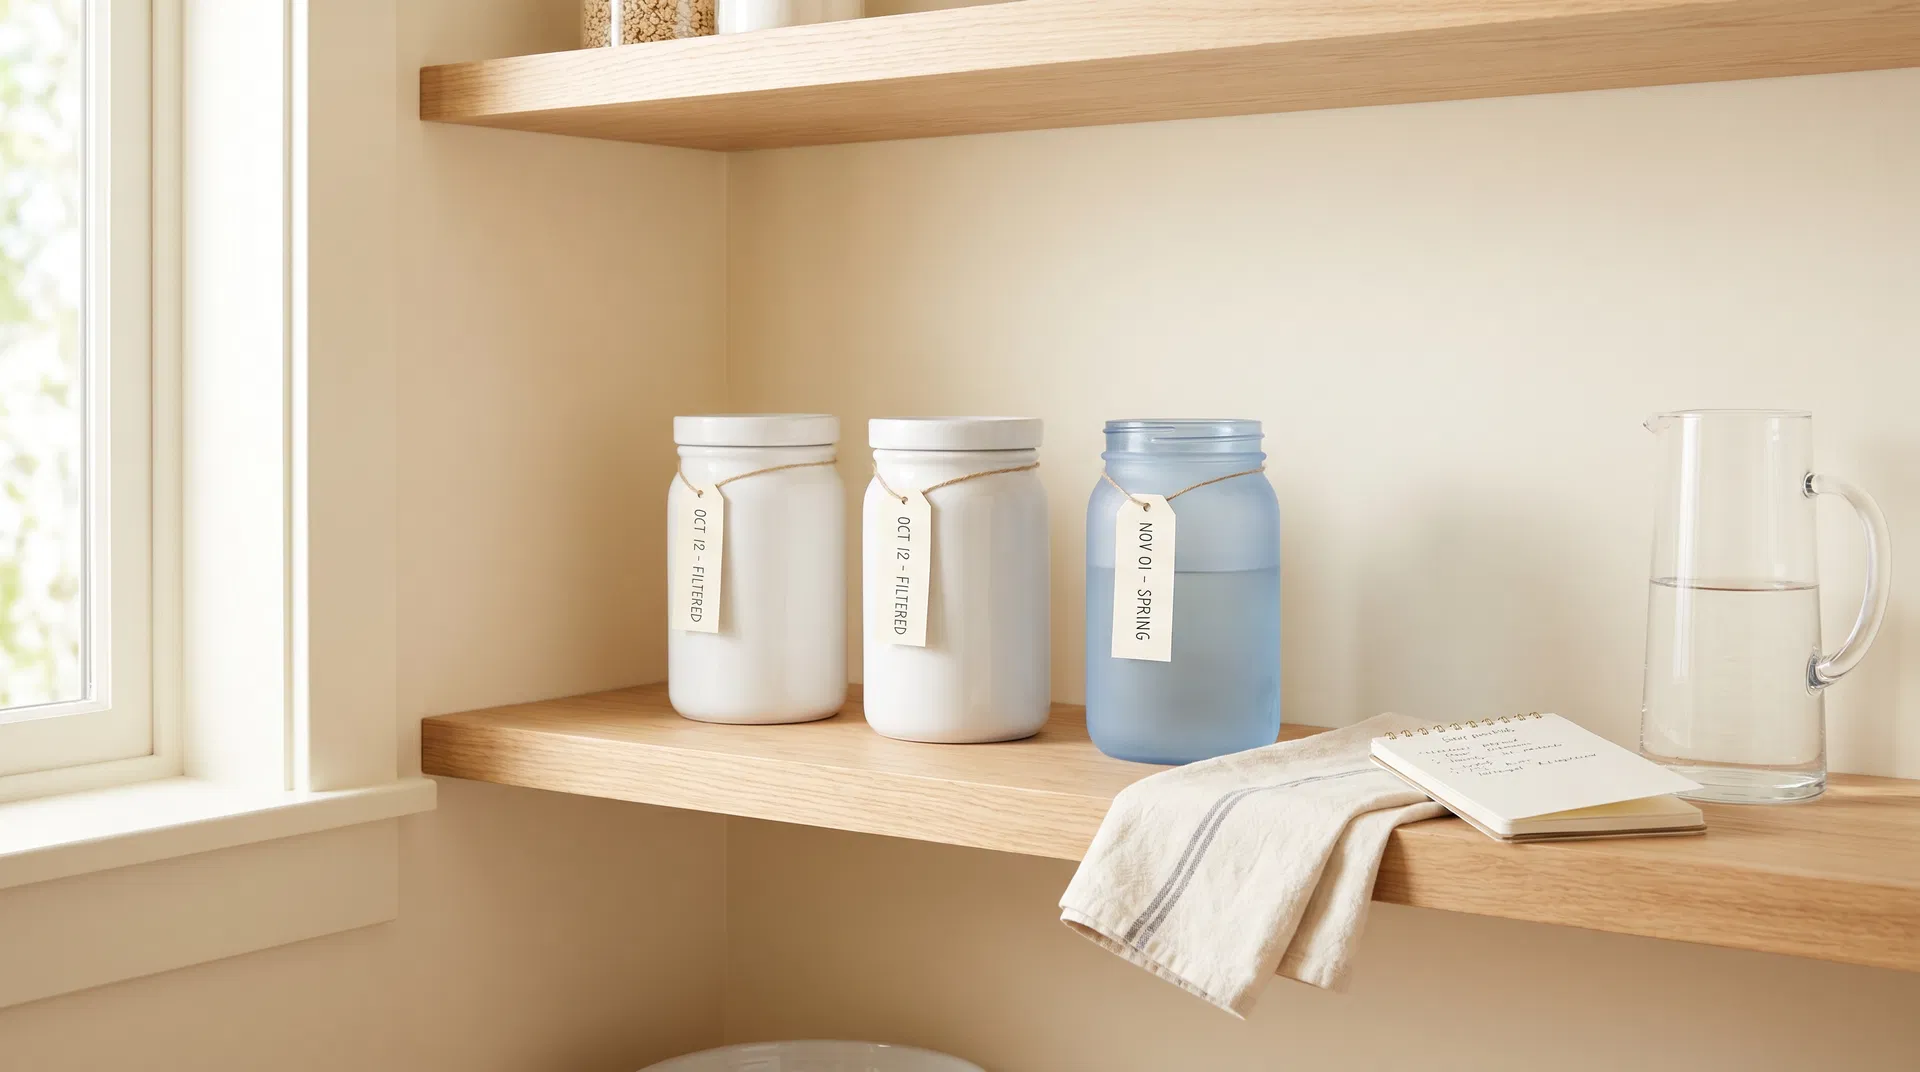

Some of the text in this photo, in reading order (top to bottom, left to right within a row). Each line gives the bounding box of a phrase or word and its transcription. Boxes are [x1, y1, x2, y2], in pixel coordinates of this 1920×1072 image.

[693, 509, 707, 534] OCT
[897, 516, 911, 542] OCT
[693, 538, 706, 551] 12
[1138, 522, 1153, 552] NOV
[896, 547, 910, 560] 12
[690, 566, 705, 623] FILTERED
[893, 576, 910, 635] FILTERED
[1135, 589, 1152, 641] SPRING
